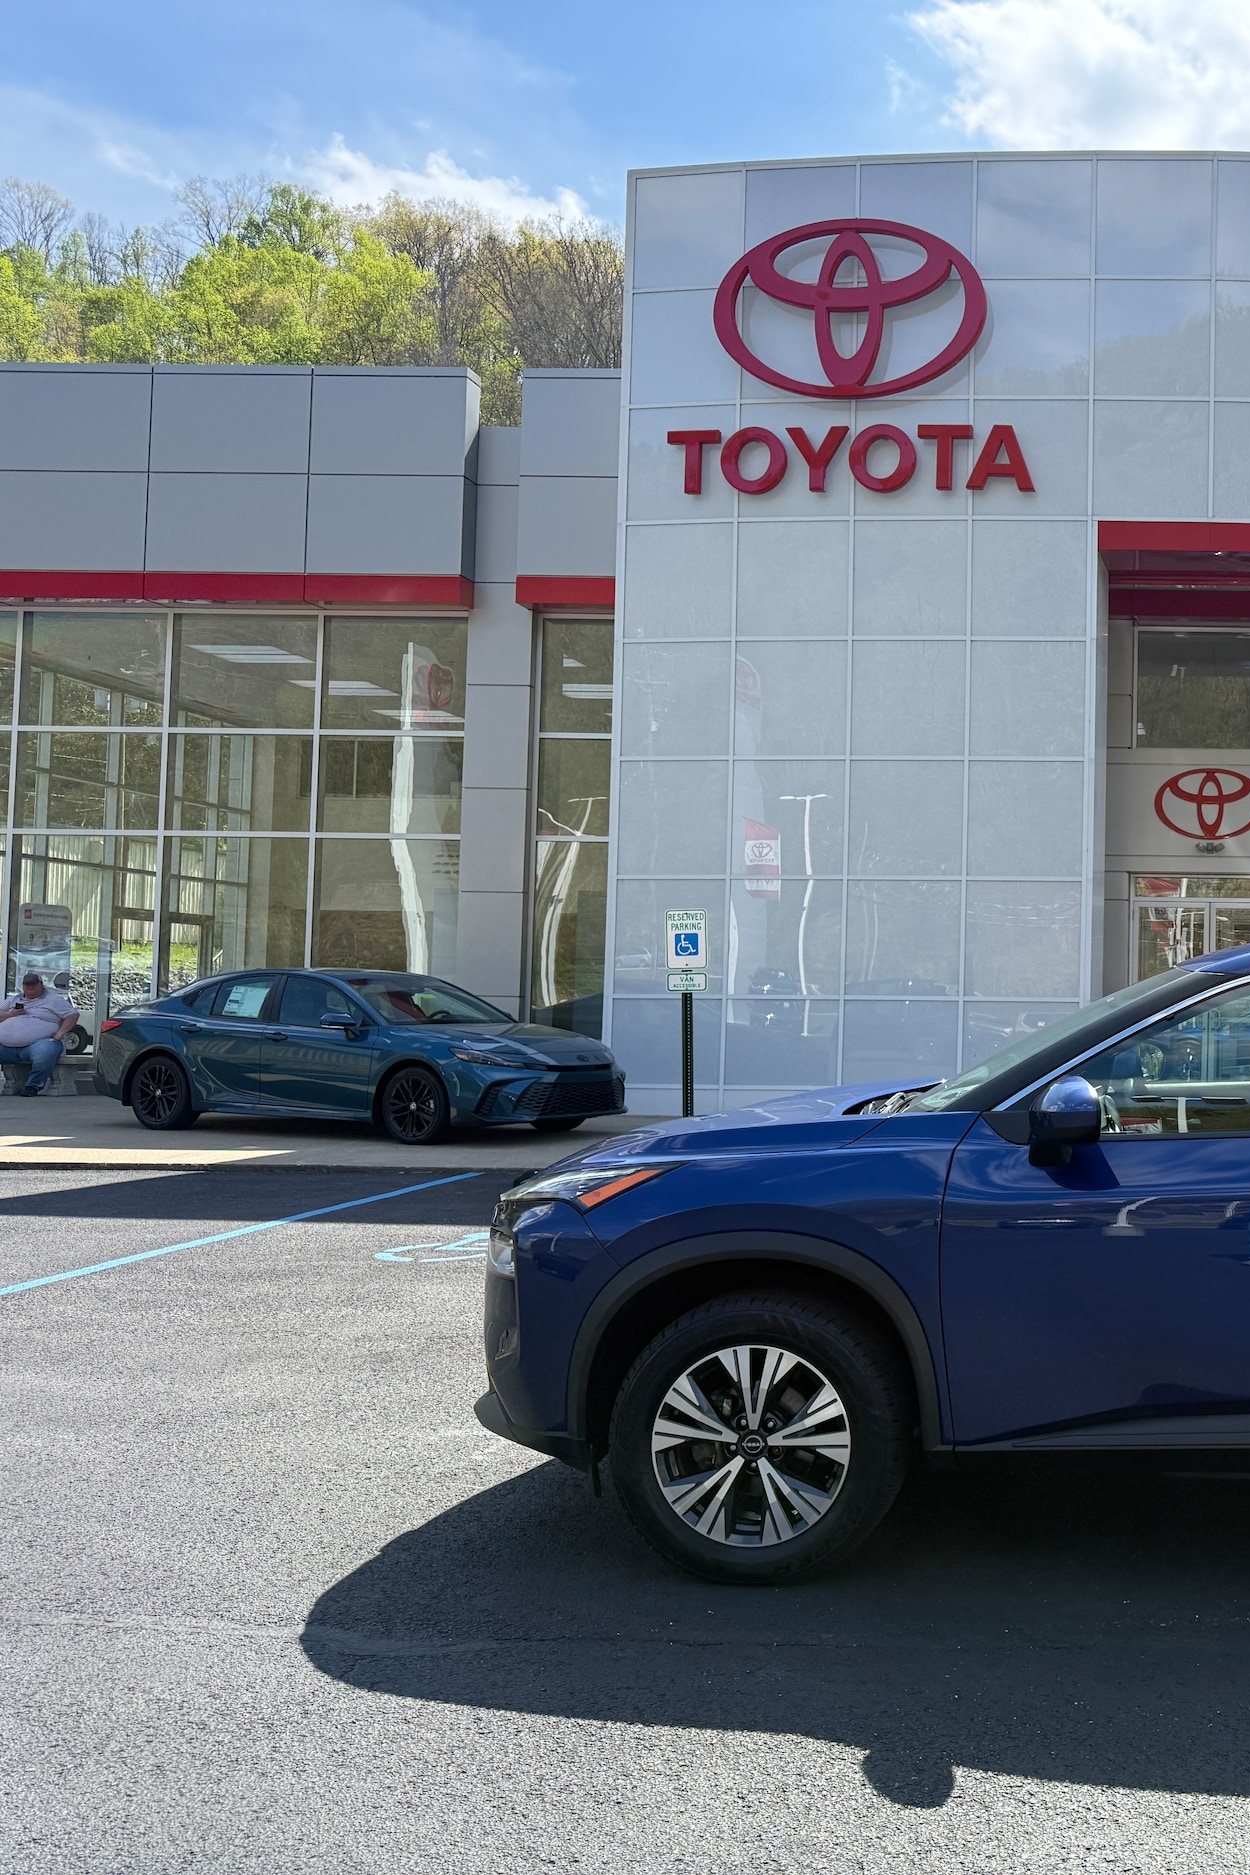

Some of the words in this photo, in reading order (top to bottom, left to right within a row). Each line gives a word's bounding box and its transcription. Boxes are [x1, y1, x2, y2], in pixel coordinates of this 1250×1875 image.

[667, 423, 1036, 495] TOYOTA
[668, 912, 704, 922] RESERVED
[671, 922, 702, 931] PARKING
